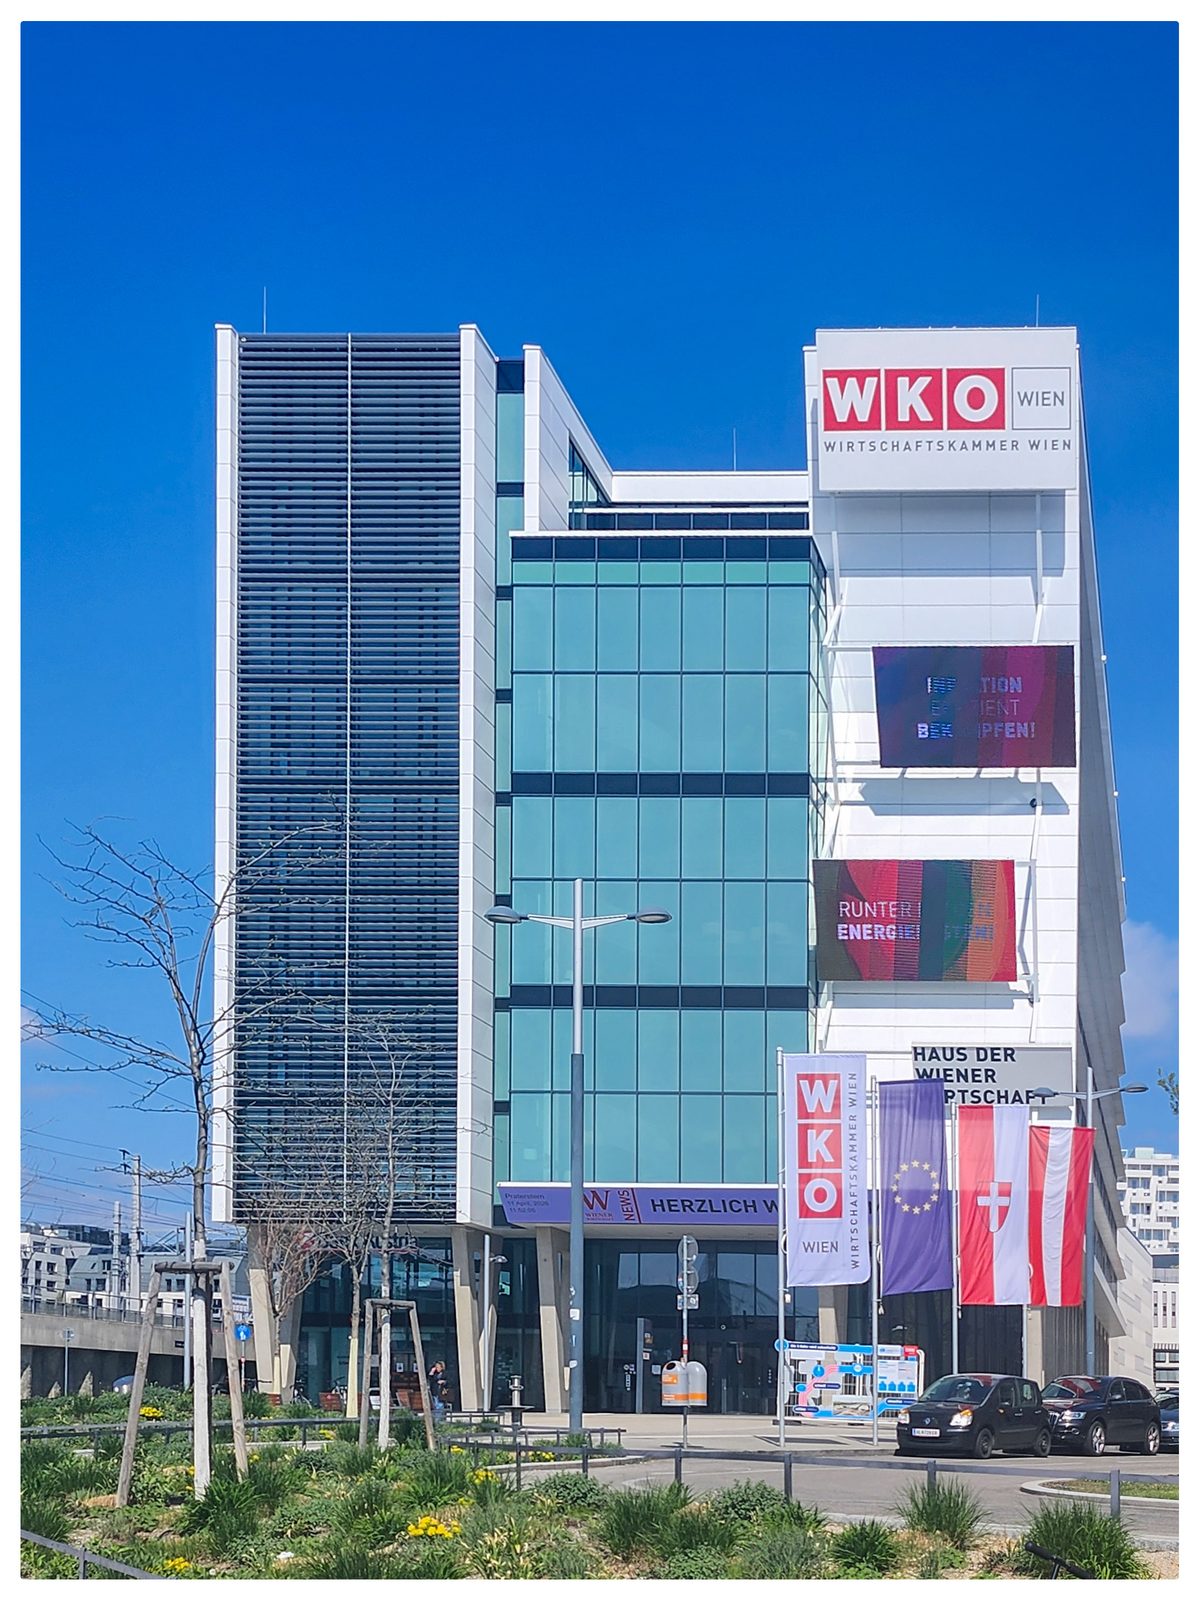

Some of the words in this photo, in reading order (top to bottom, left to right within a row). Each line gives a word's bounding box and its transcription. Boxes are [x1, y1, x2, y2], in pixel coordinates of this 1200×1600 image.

[825, 374, 1000, 423] WKO
[1017, 391, 1065, 407] WIEN
[823, 440, 1020, 453] WIRTSCHAFTSKAMMER
[1028, 438, 1073, 452] WIEN
[839, 901, 912, 918] RUNTER
[913, 1046, 968, 1062] HAUS
[976, 1047, 1016, 1062] DER
[914, 1067, 997, 1083] WIENER
[848, 1072, 858, 1108] WIEN
[944, 1089, 1047, 1105] RTSCHAF
[848, 1114, 860, 1270] WIRTSCHAFTSKAMMER
[617, 1189, 636, 1221] NEWS
[650, 1198, 758, 1213] HERZLICH
[802, 1241, 839, 1253] WIEN
